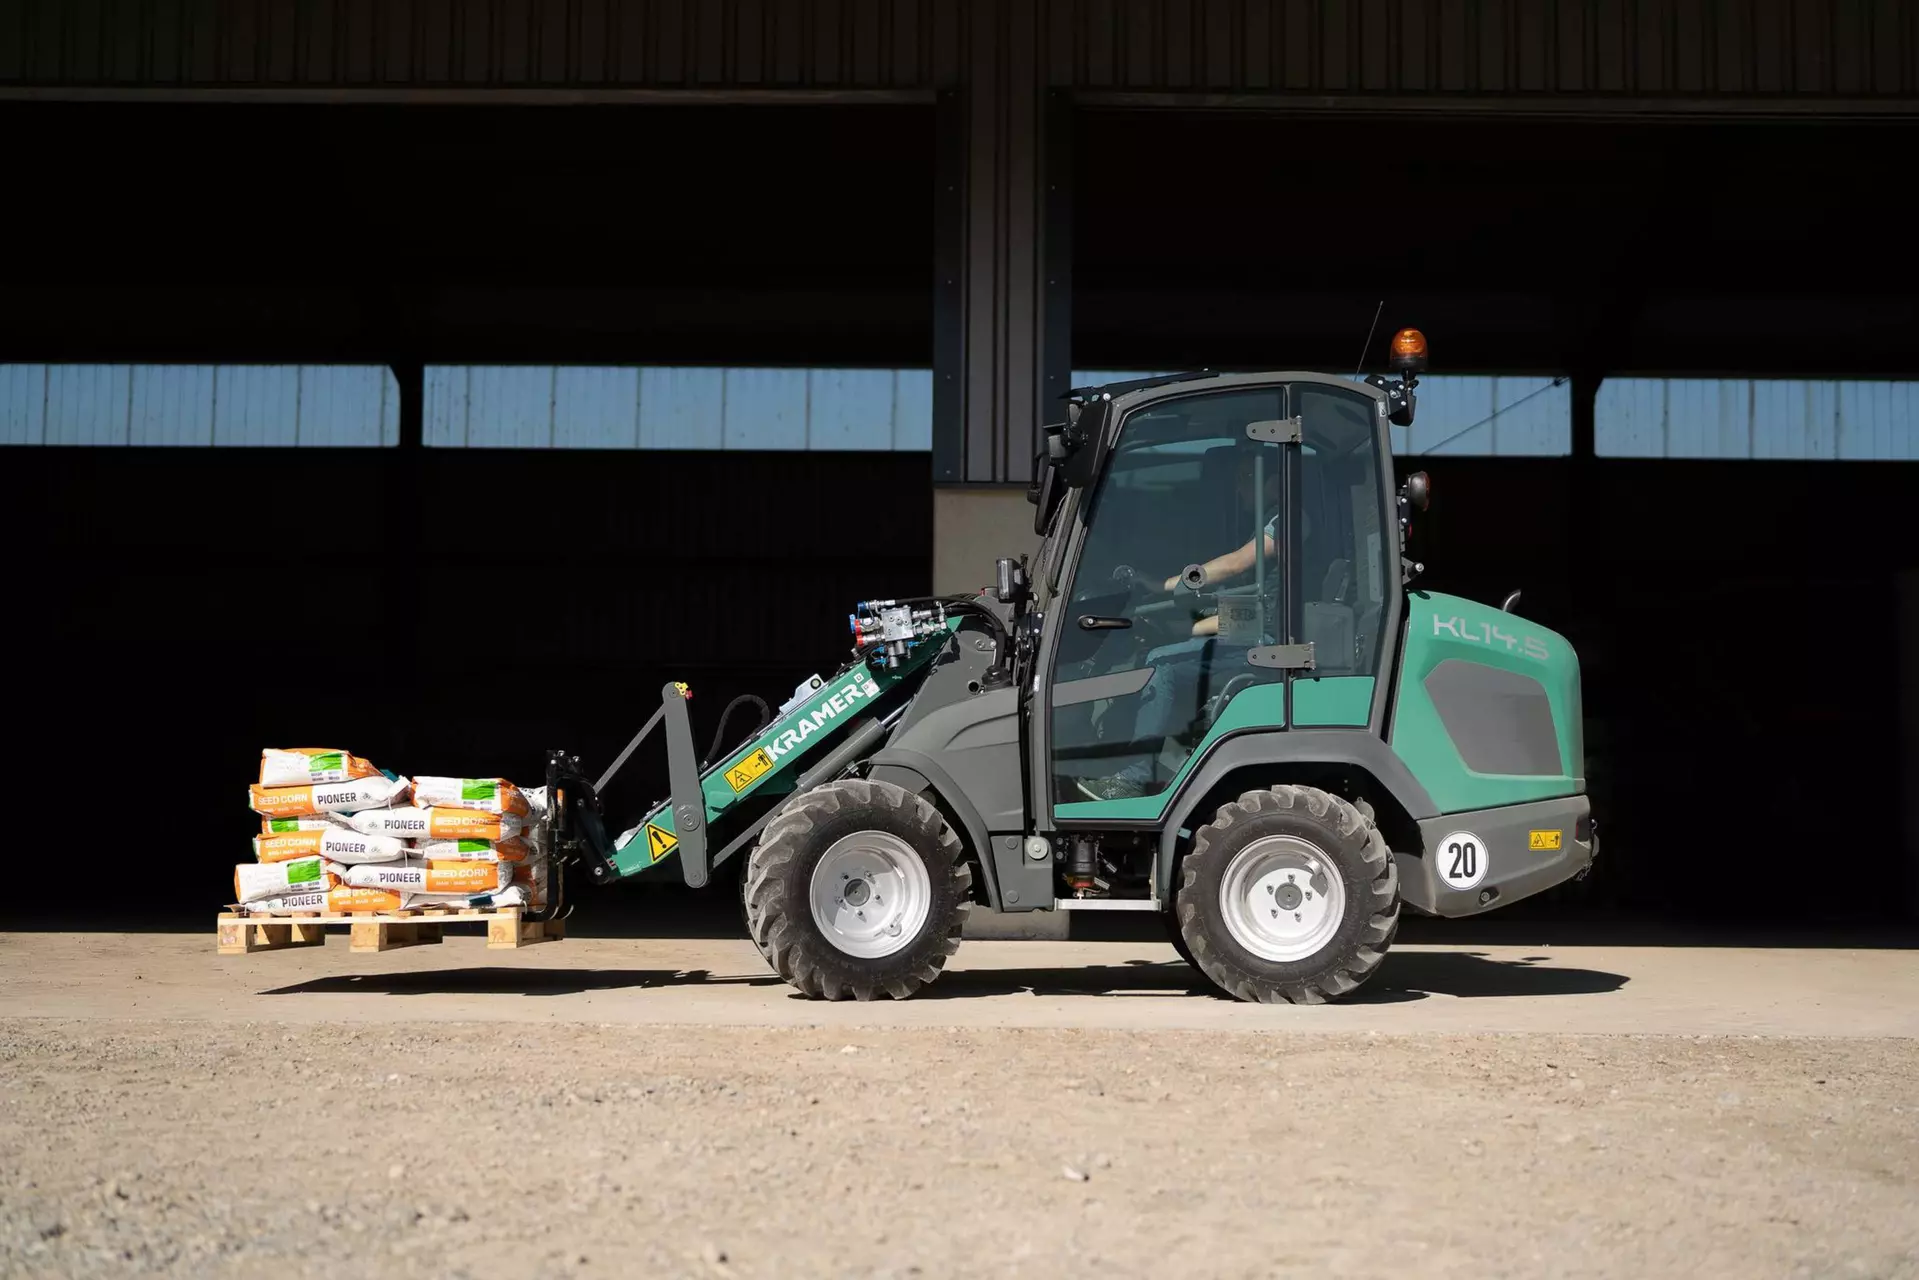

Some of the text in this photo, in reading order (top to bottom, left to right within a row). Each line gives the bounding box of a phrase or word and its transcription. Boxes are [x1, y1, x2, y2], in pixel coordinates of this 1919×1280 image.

[1434, 613, 1549, 660] KL14.5
[765, 682, 865, 761] KRAMER
[258, 793, 308, 805] SEED CORN
[317, 792, 357, 805] PIONEER
[384, 819, 425, 830] PIONEER
[325, 841, 366, 853] PIONEER
[1448, 841, 1476, 879] 20
[379, 872, 421, 883] PIONEER
[458, 868, 488, 878] CORN
[281, 895, 323, 907] PIONEER
